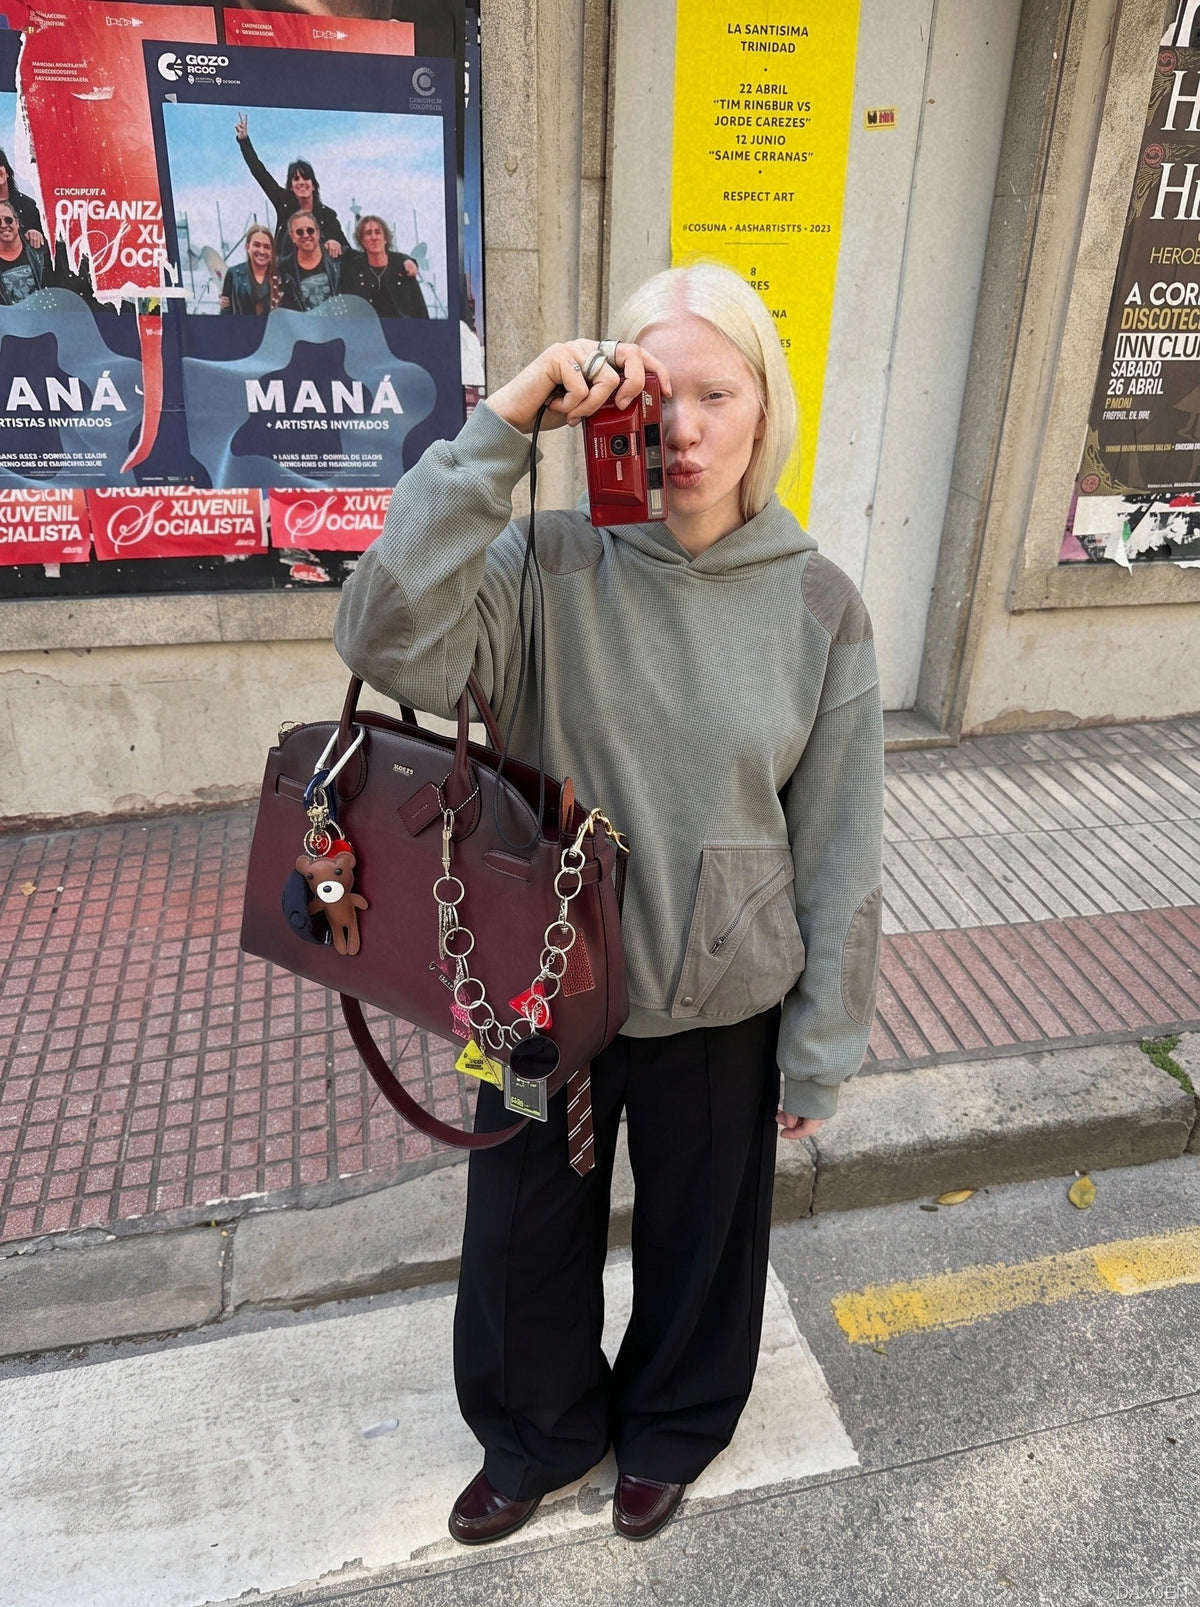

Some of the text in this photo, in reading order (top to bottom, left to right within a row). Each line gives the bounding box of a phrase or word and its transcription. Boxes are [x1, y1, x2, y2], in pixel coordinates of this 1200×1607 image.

[727, 23, 809, 37] LA SANTISIMA
[740, 41, 796, 54] TRINIDAD
[186, 54, 229, 67] GOZO
[739, 84, 788, 95] 22 ABRIL
[797, 101, 811, 112] VS
[714, 116, 752, 127] JORDE
[736, 135, 786, 146] 12 JUNIO
[723, 191, 795, 202] RESPECT ART
[810, 224, 831, 233] 2023
[750, 267, 757, 276] 8
[747, 280, 770, 290] RES
[1124, 281, 1200, 306] A COR
[768, 309, 787, 319] NA
[1121, 307, 1200, 330] DISCOTEC
[1116, 335, 1200, 358] INN CLU
[1111, 360, 1162, 378] SABADO
[1107, 378, 1164, 395] 26 ABRIL
[245, 374, 404, 414] MANÁ
[48, 417, 112, 428] INVITADOS
[275, 419, 327, 430] ARTISTAS
[330, 419, 390, 430] INVITADOS
[170, 499, 254, 516] XUVENIL
